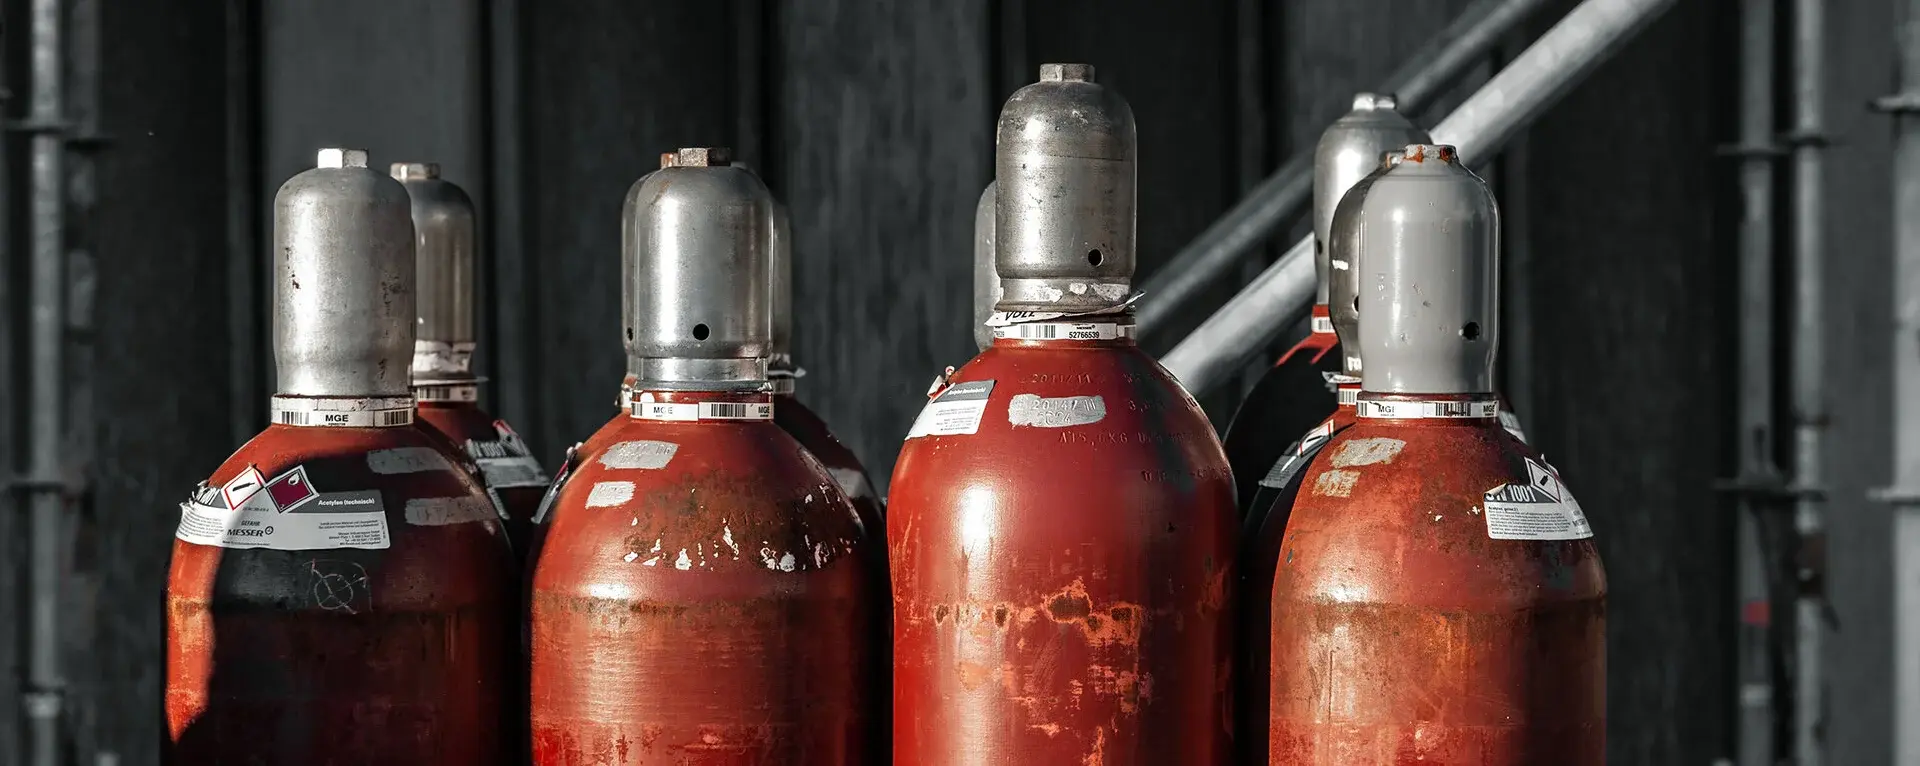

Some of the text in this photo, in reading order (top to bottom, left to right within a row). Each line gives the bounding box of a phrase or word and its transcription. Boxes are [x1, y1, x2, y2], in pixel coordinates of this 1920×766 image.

[1069, 331, 1099, 339] 52766539
[325, 414, 349, 422] MGE
[1507, 484, 1537, 502] 1001
[227, 528, 264, 537] MESSER
